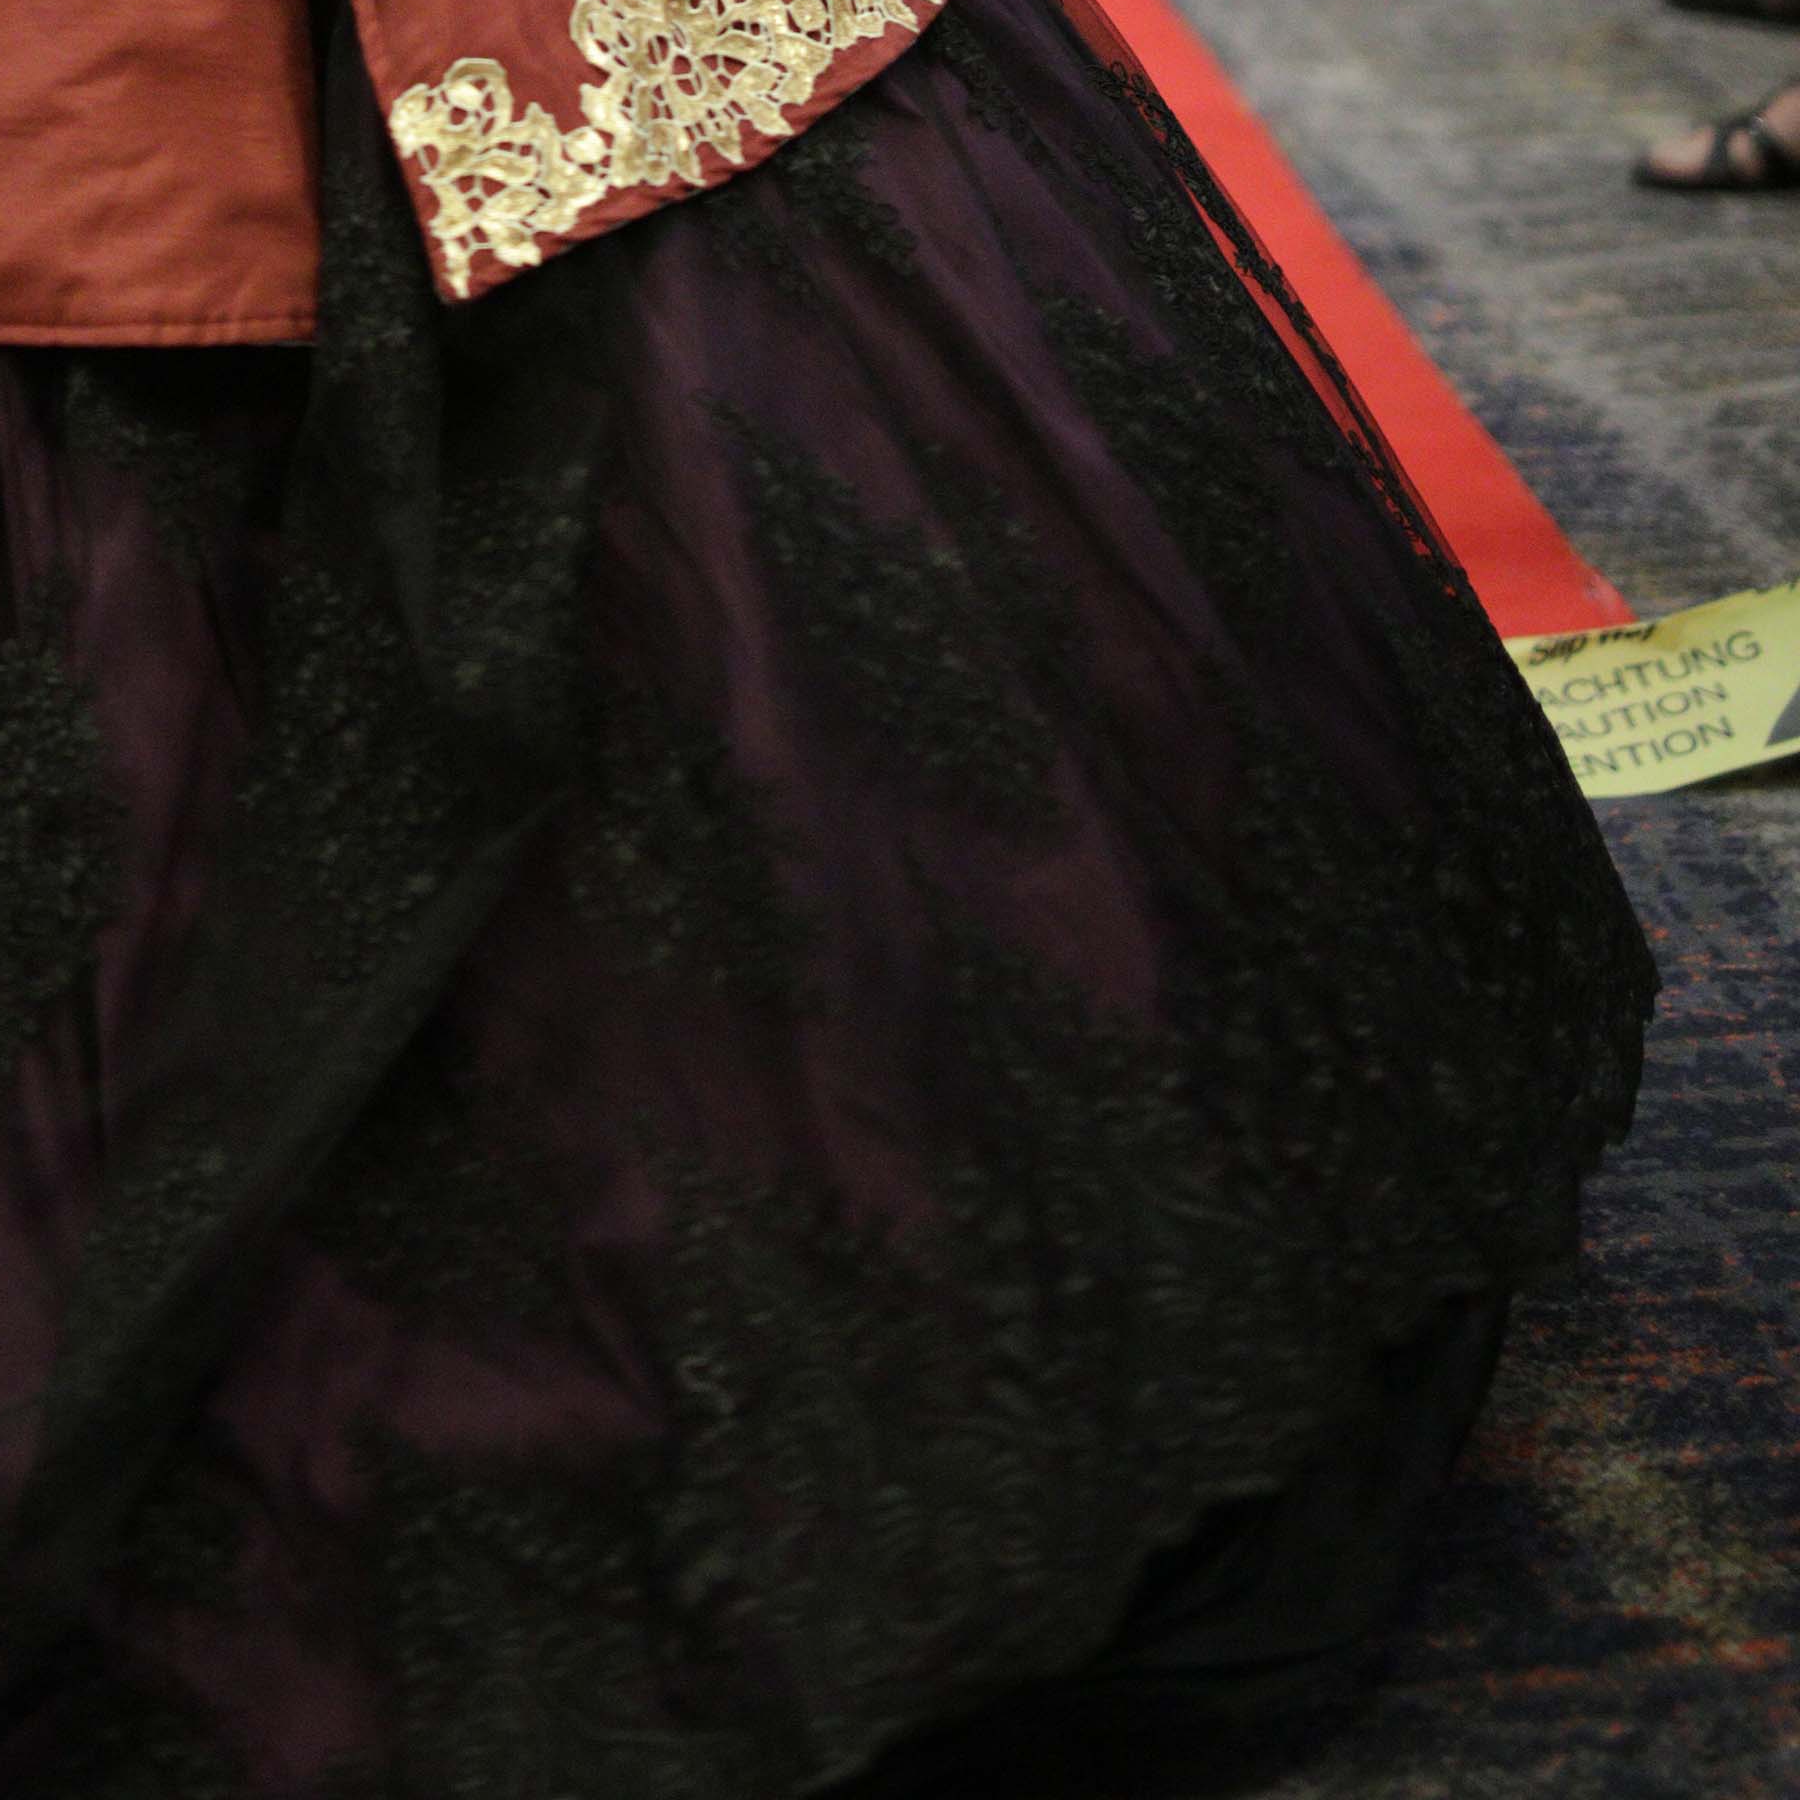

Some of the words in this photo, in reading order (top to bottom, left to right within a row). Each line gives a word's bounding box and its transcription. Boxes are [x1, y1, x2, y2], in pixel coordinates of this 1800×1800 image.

[1538, 630, 1762, 708] ACHTUNG
[1555, 682, 1728, 741] AUTION
[1568, 715, 1734, 778] ENTION
